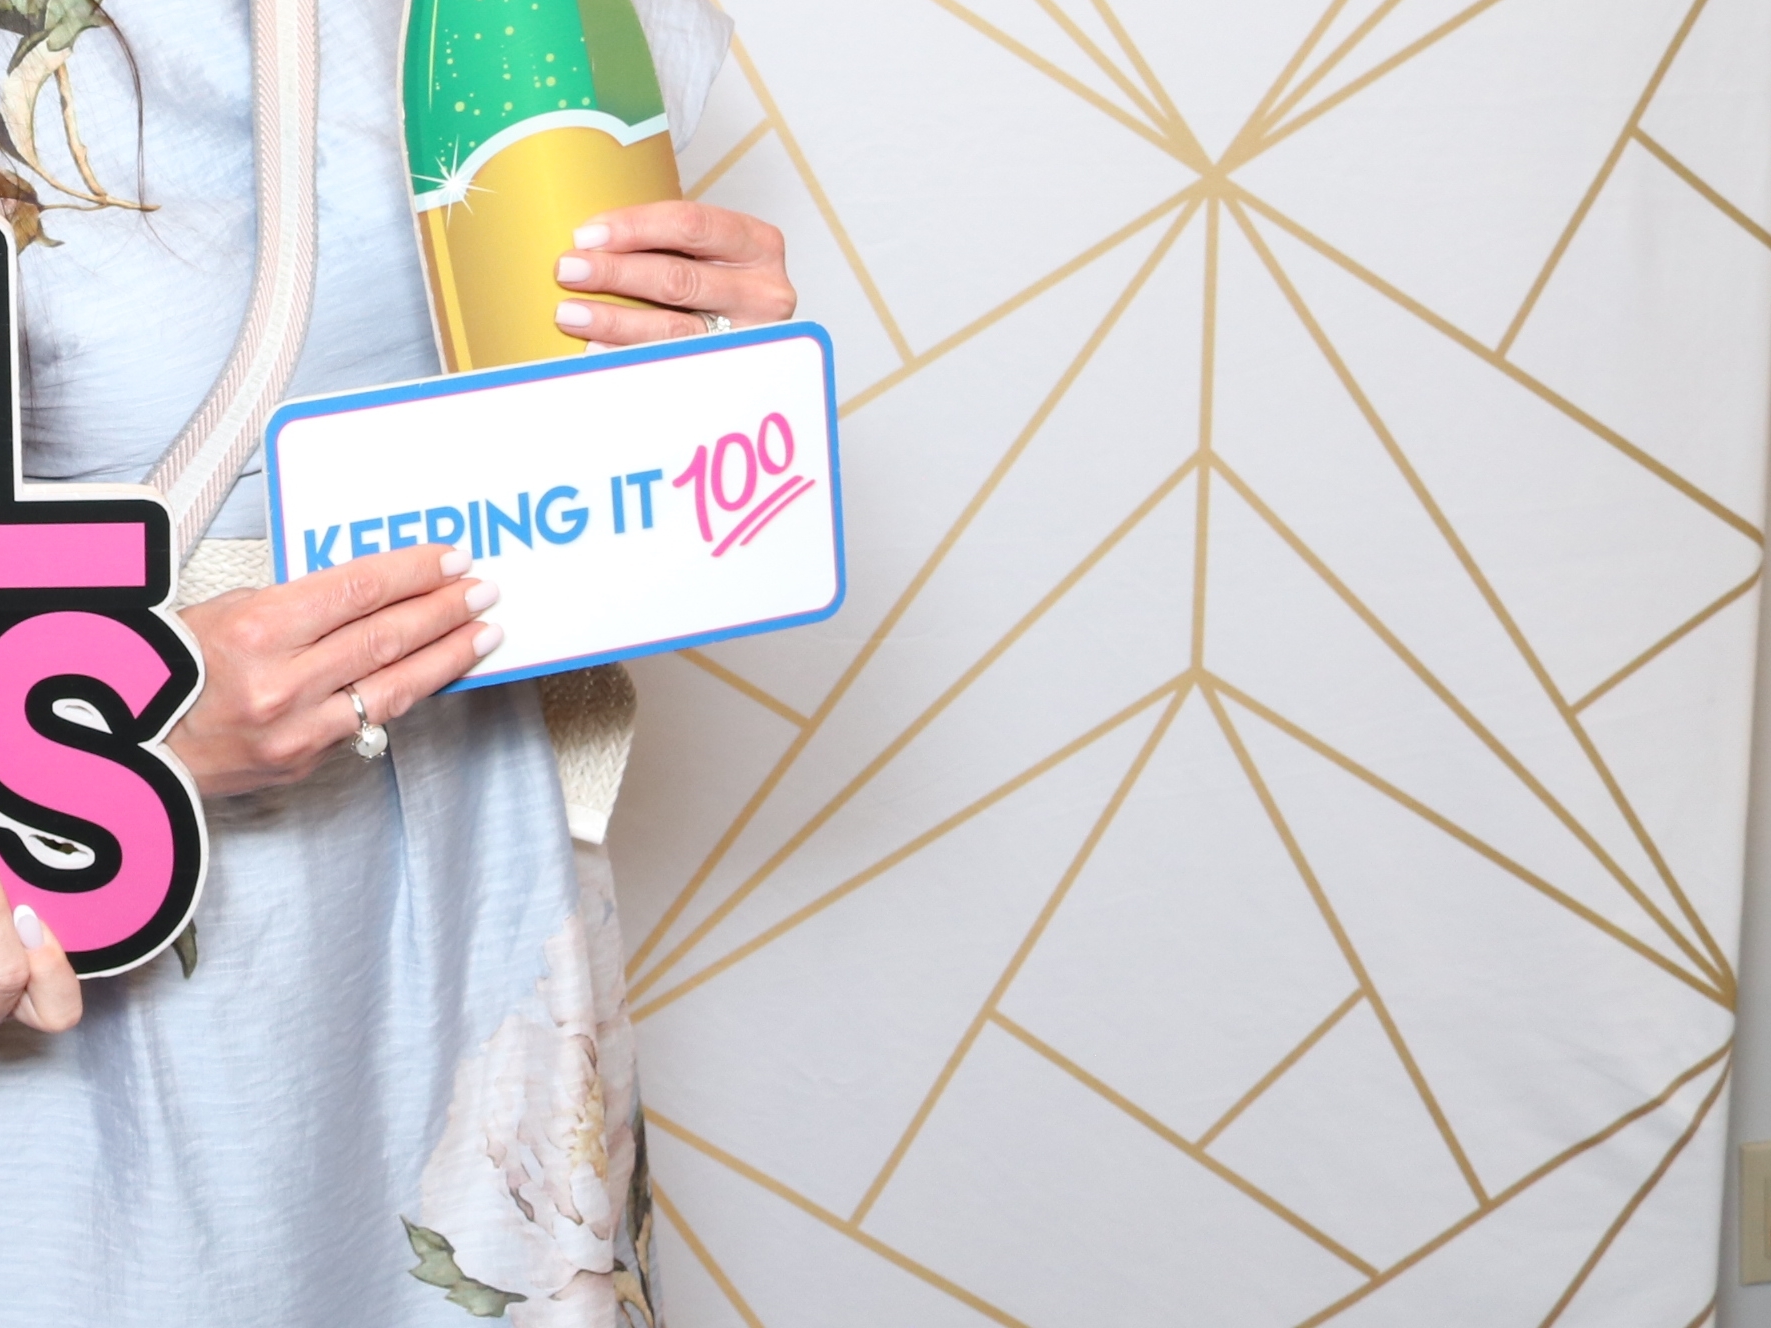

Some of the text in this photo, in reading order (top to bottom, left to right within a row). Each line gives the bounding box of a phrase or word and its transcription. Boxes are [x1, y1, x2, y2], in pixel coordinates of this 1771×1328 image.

[303, 411, 795, 575] KEEPING IT 100
